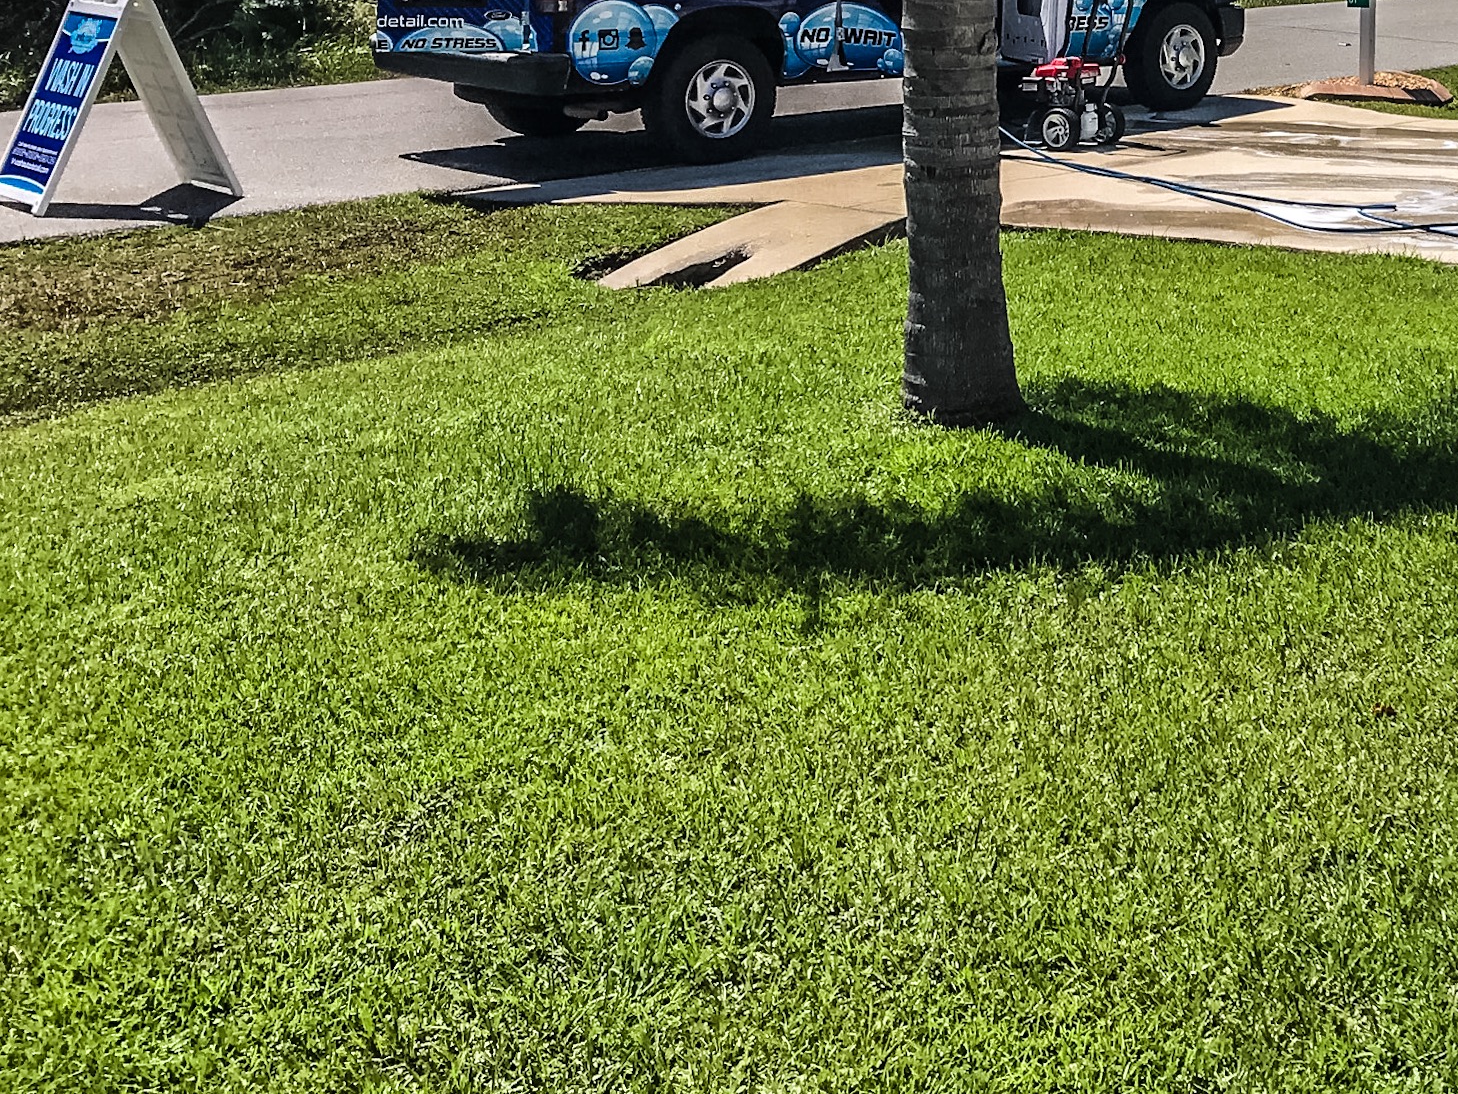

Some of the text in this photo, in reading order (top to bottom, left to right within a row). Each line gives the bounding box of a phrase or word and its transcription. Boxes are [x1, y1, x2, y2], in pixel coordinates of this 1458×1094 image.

[401, 38, 497, 49] NO STRESS
[800, 27, 897, 47] NO WAIT
[45, 57, 95, 98] WASH IN
[22, 98, 78, 141] PROGRESS
